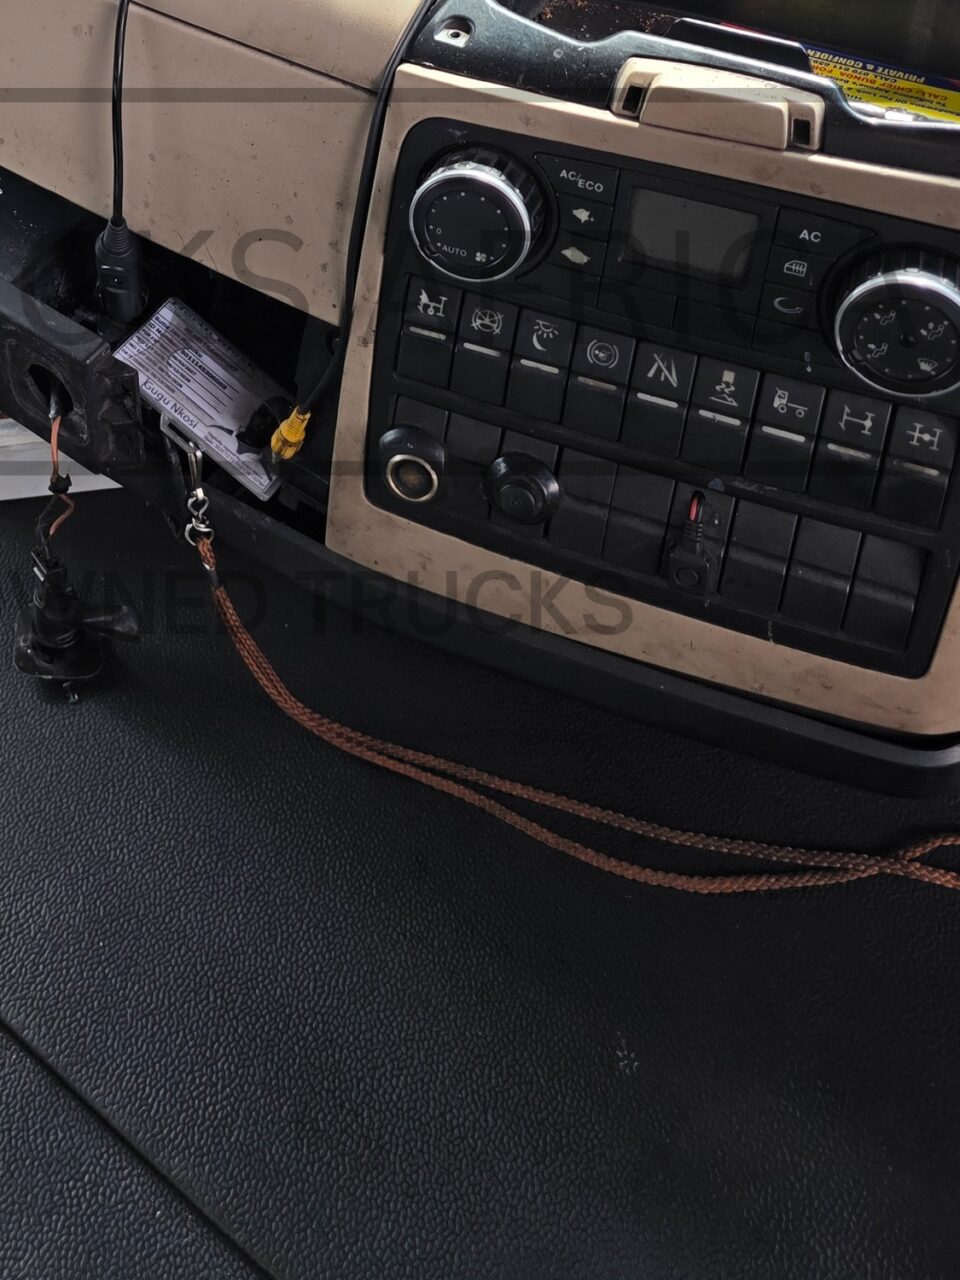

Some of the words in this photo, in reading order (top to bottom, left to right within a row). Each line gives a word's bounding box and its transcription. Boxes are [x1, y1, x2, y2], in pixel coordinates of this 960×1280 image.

[807, 49, 864, 69] CONFIDEN
[866, 62, 874, 70] &
[839, 70, 877, 85] BUNDA
[874, 73, 897, 83] CALL
[877, 66, 926, 83] PRIVATE
[880, 81, 913, 94] CHIEF
[559, 169, 604, 192] AC/ECO
[798, 229, 822, 243] AC
[442, 244, 467, 257] AUTO
[142, 379, 172, 407] Gugu
[169, 402, 199, 429] Nkosi
